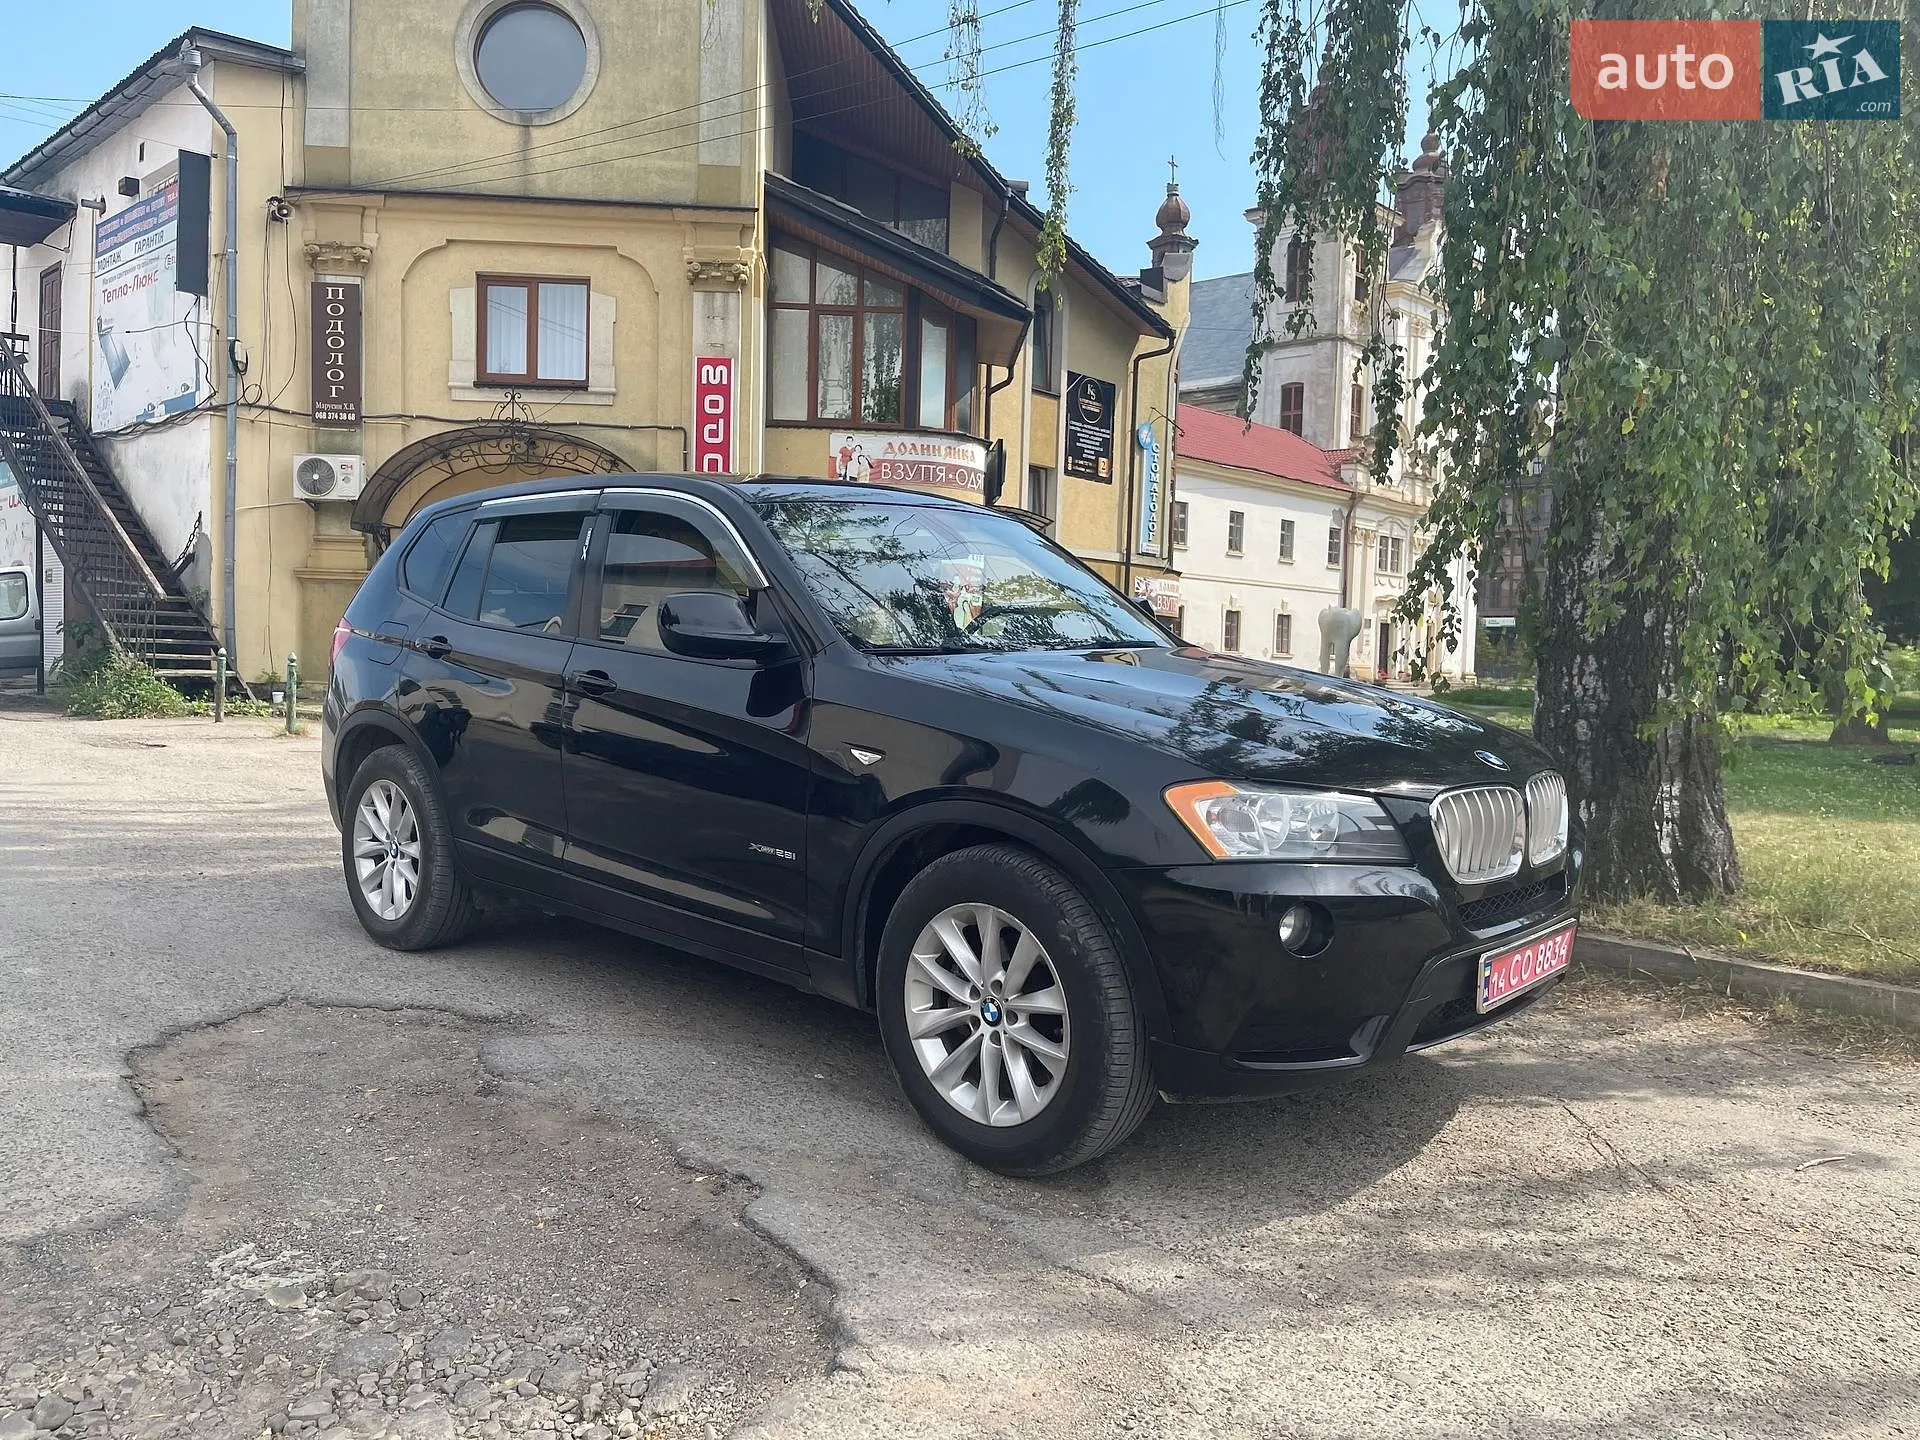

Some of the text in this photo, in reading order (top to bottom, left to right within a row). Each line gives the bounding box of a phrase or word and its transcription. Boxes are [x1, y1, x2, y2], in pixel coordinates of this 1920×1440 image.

[97, 250, 122, 272] МОНТАЖ
[134, 230, 164, 255] ГАРАНТІЯ
[102, 269, 159, 304] Тепло-Люкс
[325, 286, 345, 398] ПОДОЛОГ
[881, 462, 946, 483] ВЗУТТЯ
[883, 441, 976, 463] ДОЛИНЯНКА
[1147, 443, 1160, 542] СТОМАТОЛОГ
[1491, 967, 1506, 997] 14
[1535, 931, 1569, 974] 8834
